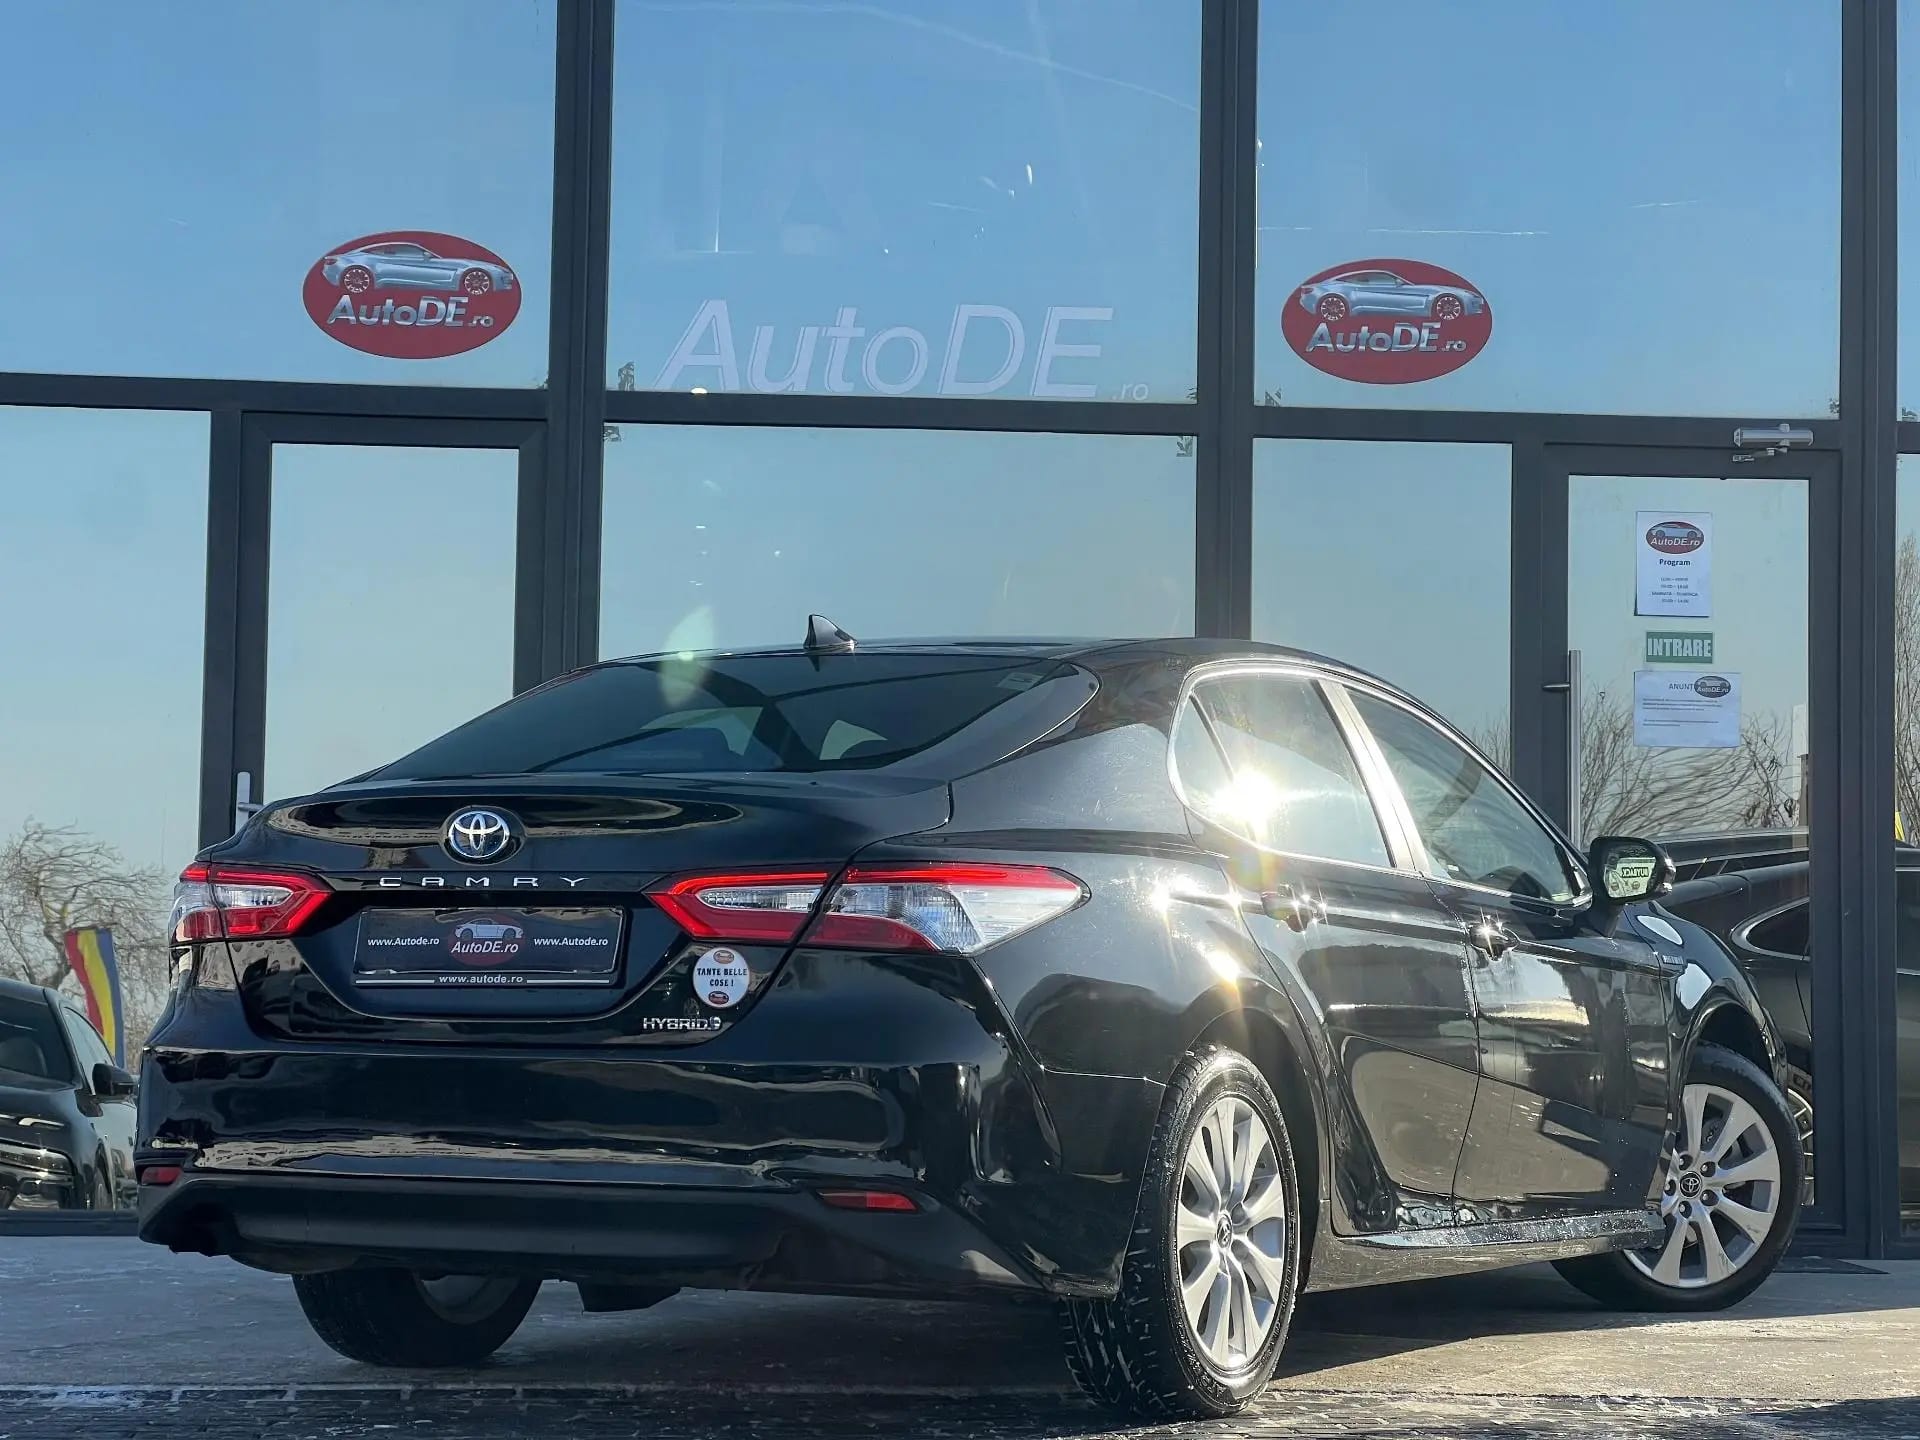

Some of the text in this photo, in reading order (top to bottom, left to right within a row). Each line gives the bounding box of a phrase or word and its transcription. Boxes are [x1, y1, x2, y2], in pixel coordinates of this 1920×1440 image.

[1650, 537, 1701, 546] AutoDE.ro
[1659, 558, 1691, 567] Program
[1647, 638, 1712, 657] INTRARE
[379, 876, 591, 888] CAMRY
[367, 937, 440, 946] www.Autode.ro
[534, 937, 608, 946] www.Autode.ro
[450, 940, 519, 953] AutoDE.ro
[697, 968, 748, 976] TANTE BELLE
[439, 974, 523, 984] www.autode.ro
[709, 979, 728, 987] COSE
[643, 1017, 708, 1030] HYBRID
